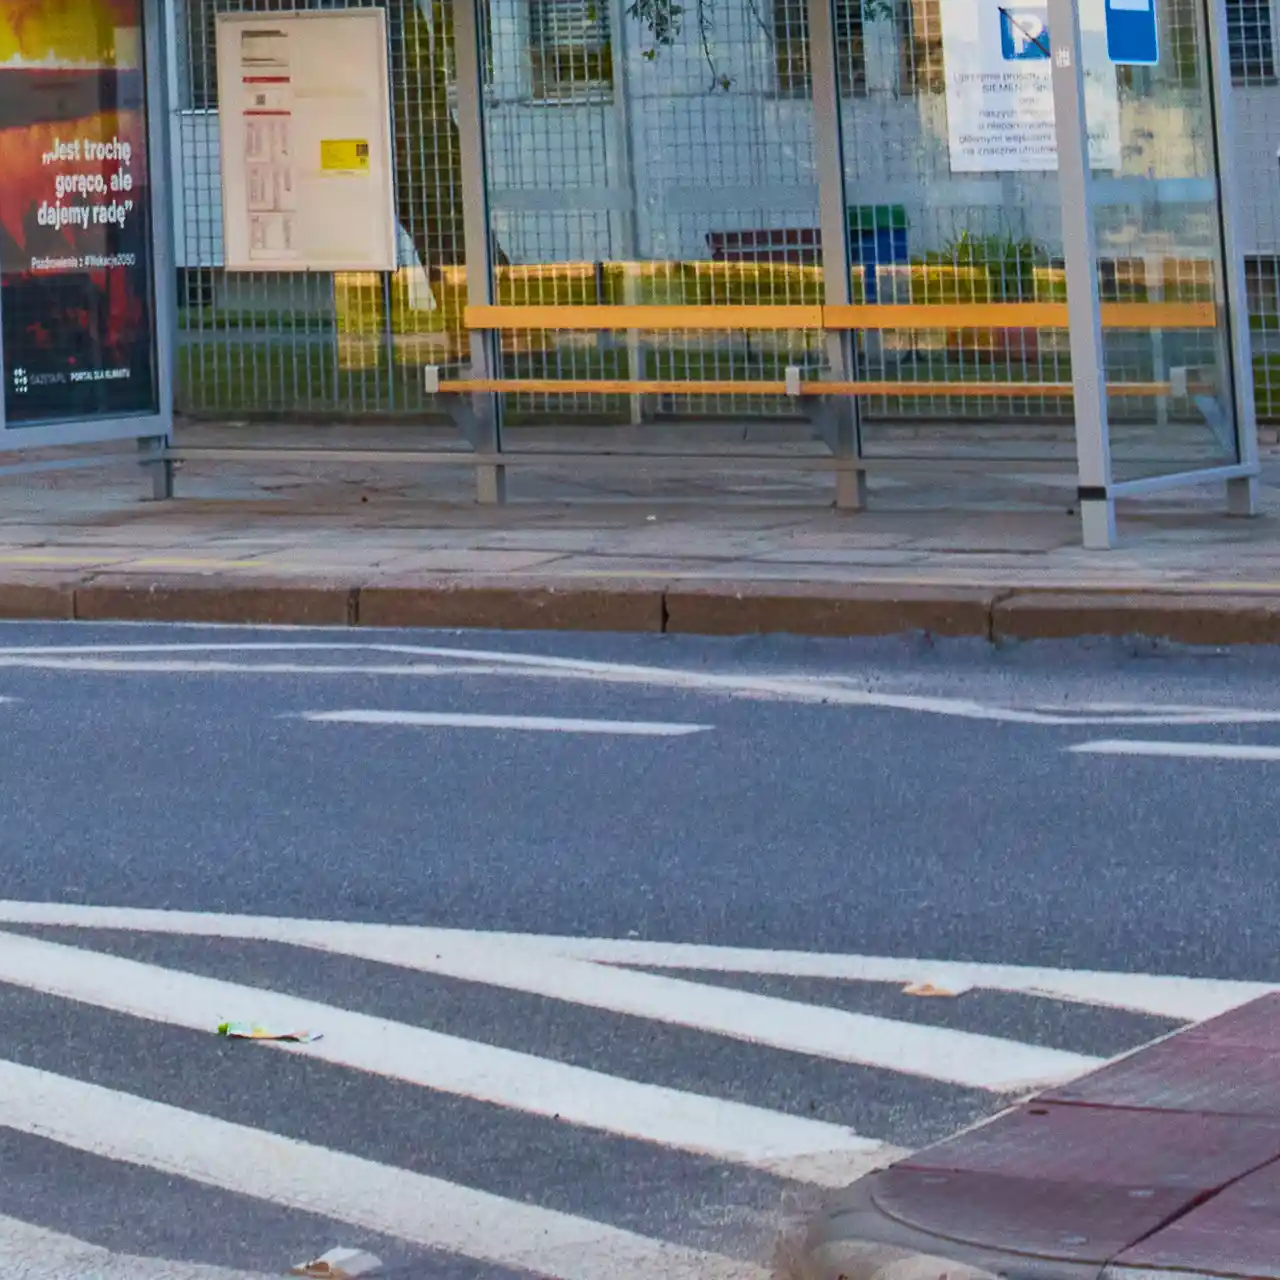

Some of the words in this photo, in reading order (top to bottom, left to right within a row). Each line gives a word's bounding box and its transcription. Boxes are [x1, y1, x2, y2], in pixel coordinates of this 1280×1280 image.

[84, 135, 131, 166] trochę
[55, 173, 107, 199] gorąco,
[110, 168, 132, 192] ale
[37, 200, 90, 230] dajemy
[93, 199, 133, 228] radę”
